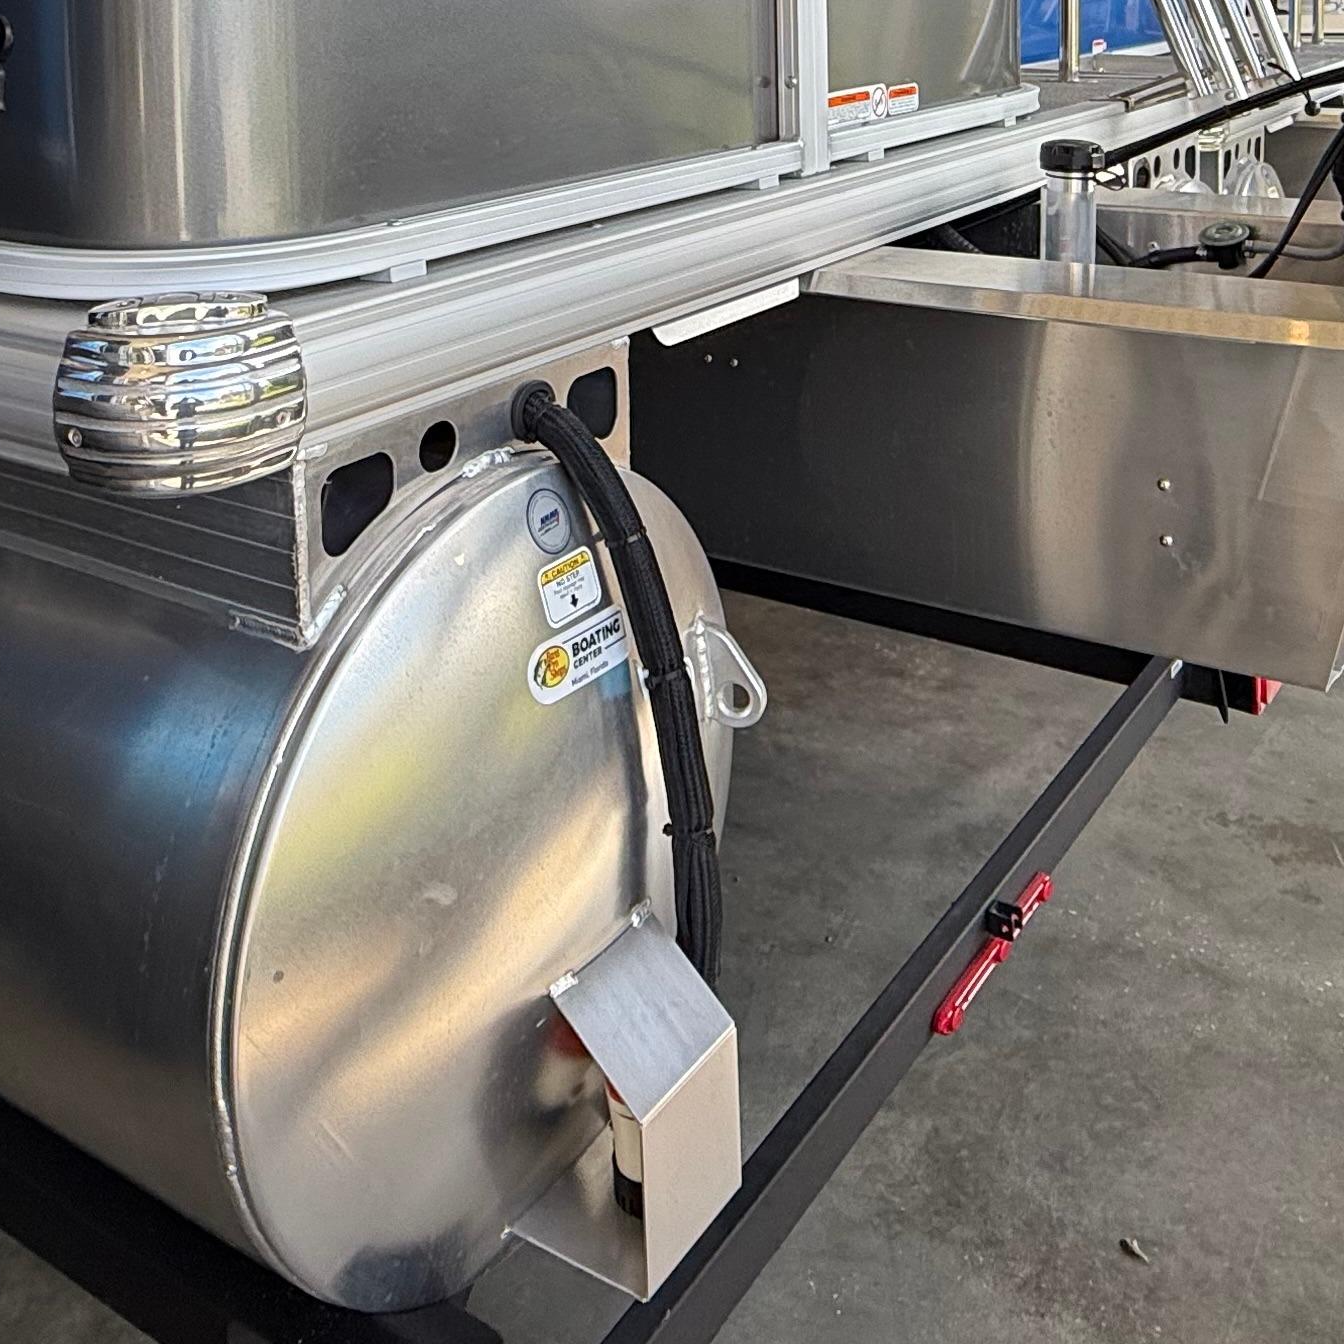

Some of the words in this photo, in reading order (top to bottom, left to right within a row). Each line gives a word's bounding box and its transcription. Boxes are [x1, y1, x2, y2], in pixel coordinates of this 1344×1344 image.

[552, 559, 580, 577] CAUTION
[572, 618, 620, 657] BOATING
[573, 646, 603, 670] CENTER
